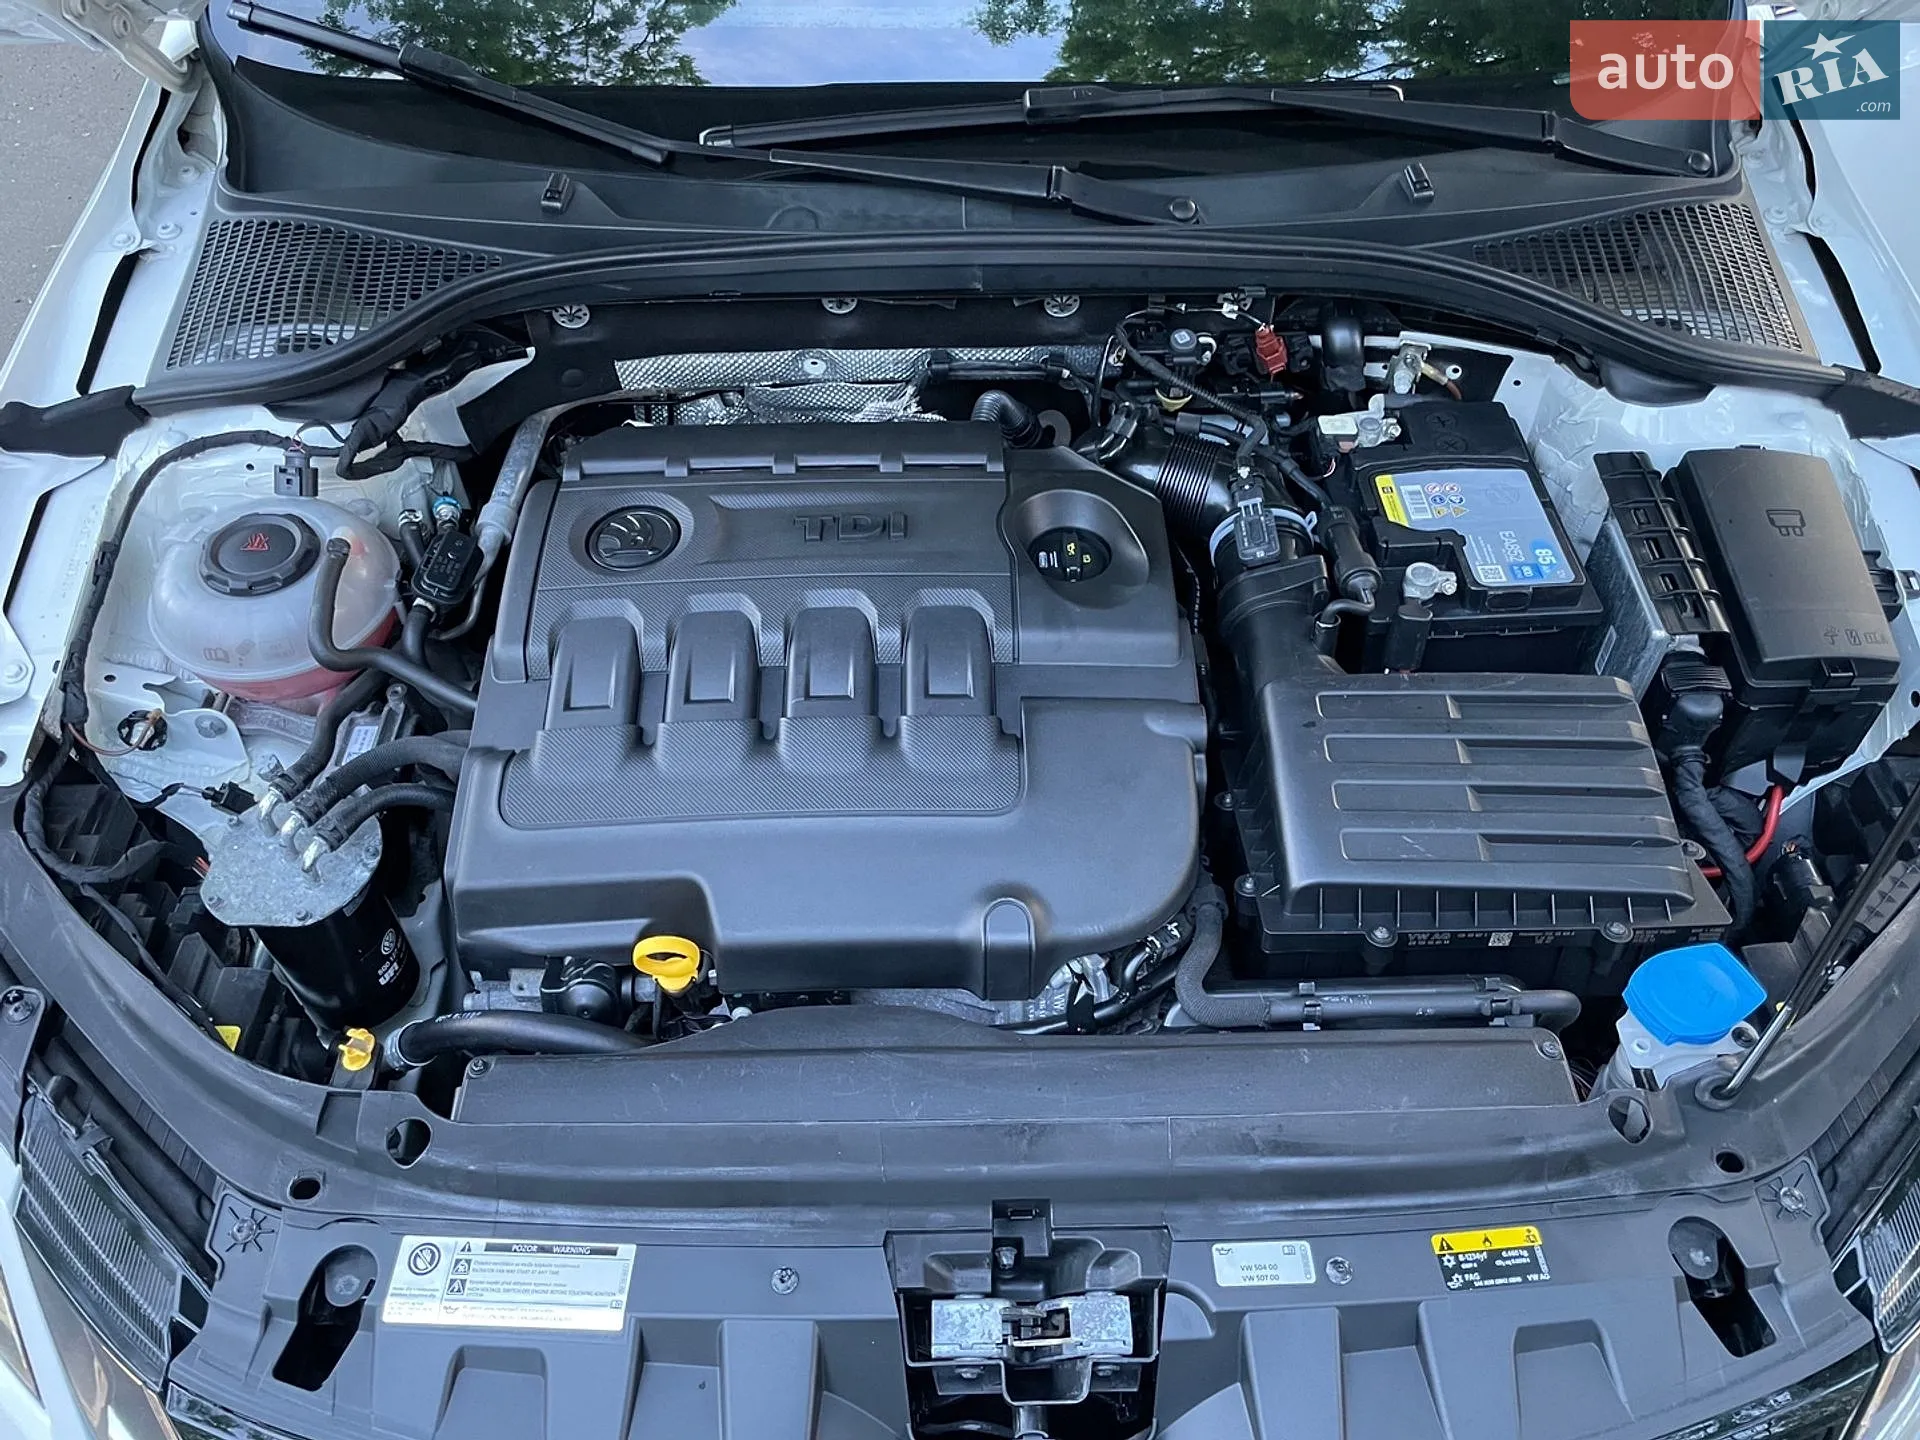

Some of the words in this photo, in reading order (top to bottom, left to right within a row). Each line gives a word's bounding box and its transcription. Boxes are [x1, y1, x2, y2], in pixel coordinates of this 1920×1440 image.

[793, 512, 908, 541] TDI
[1499, 530, 1525, 562] EA852
[1535, 548, 1557, 565] 85
[512, 1244, 538, 1252] POZOR
[553, 1245, 591, 1254] WARNING
[1464, 1272, 1480, 1281] PAG
